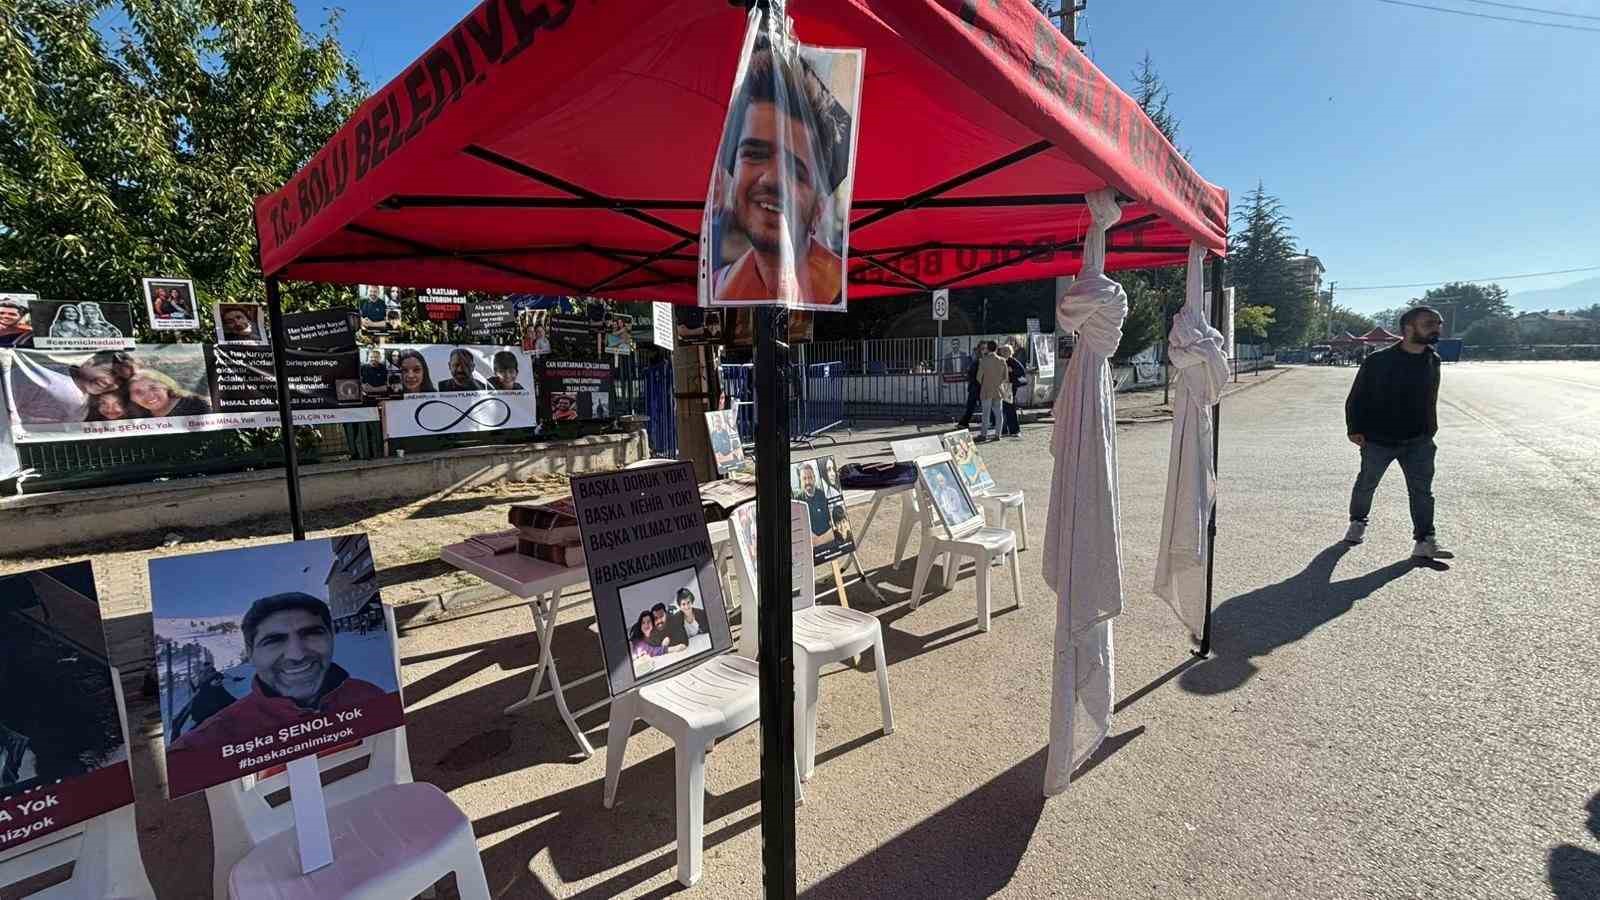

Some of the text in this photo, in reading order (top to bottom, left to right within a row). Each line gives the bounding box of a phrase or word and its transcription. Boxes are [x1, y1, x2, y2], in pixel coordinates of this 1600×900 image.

[269, 197, 297, 248] T.C.
[297, 139, 349, 227] BOLU
[578, 467, 689, 499] BAŞKA DORUK YOK!
[585, 490, 693, 526] BAŞKA NEHİR YOK!
[590, 512, 699, 552] BAŞKA YILMAZ YOK!
[222, 707, 363, 758] Başka ŞENOL Yok
[17, 794, 59, 816] Yok
